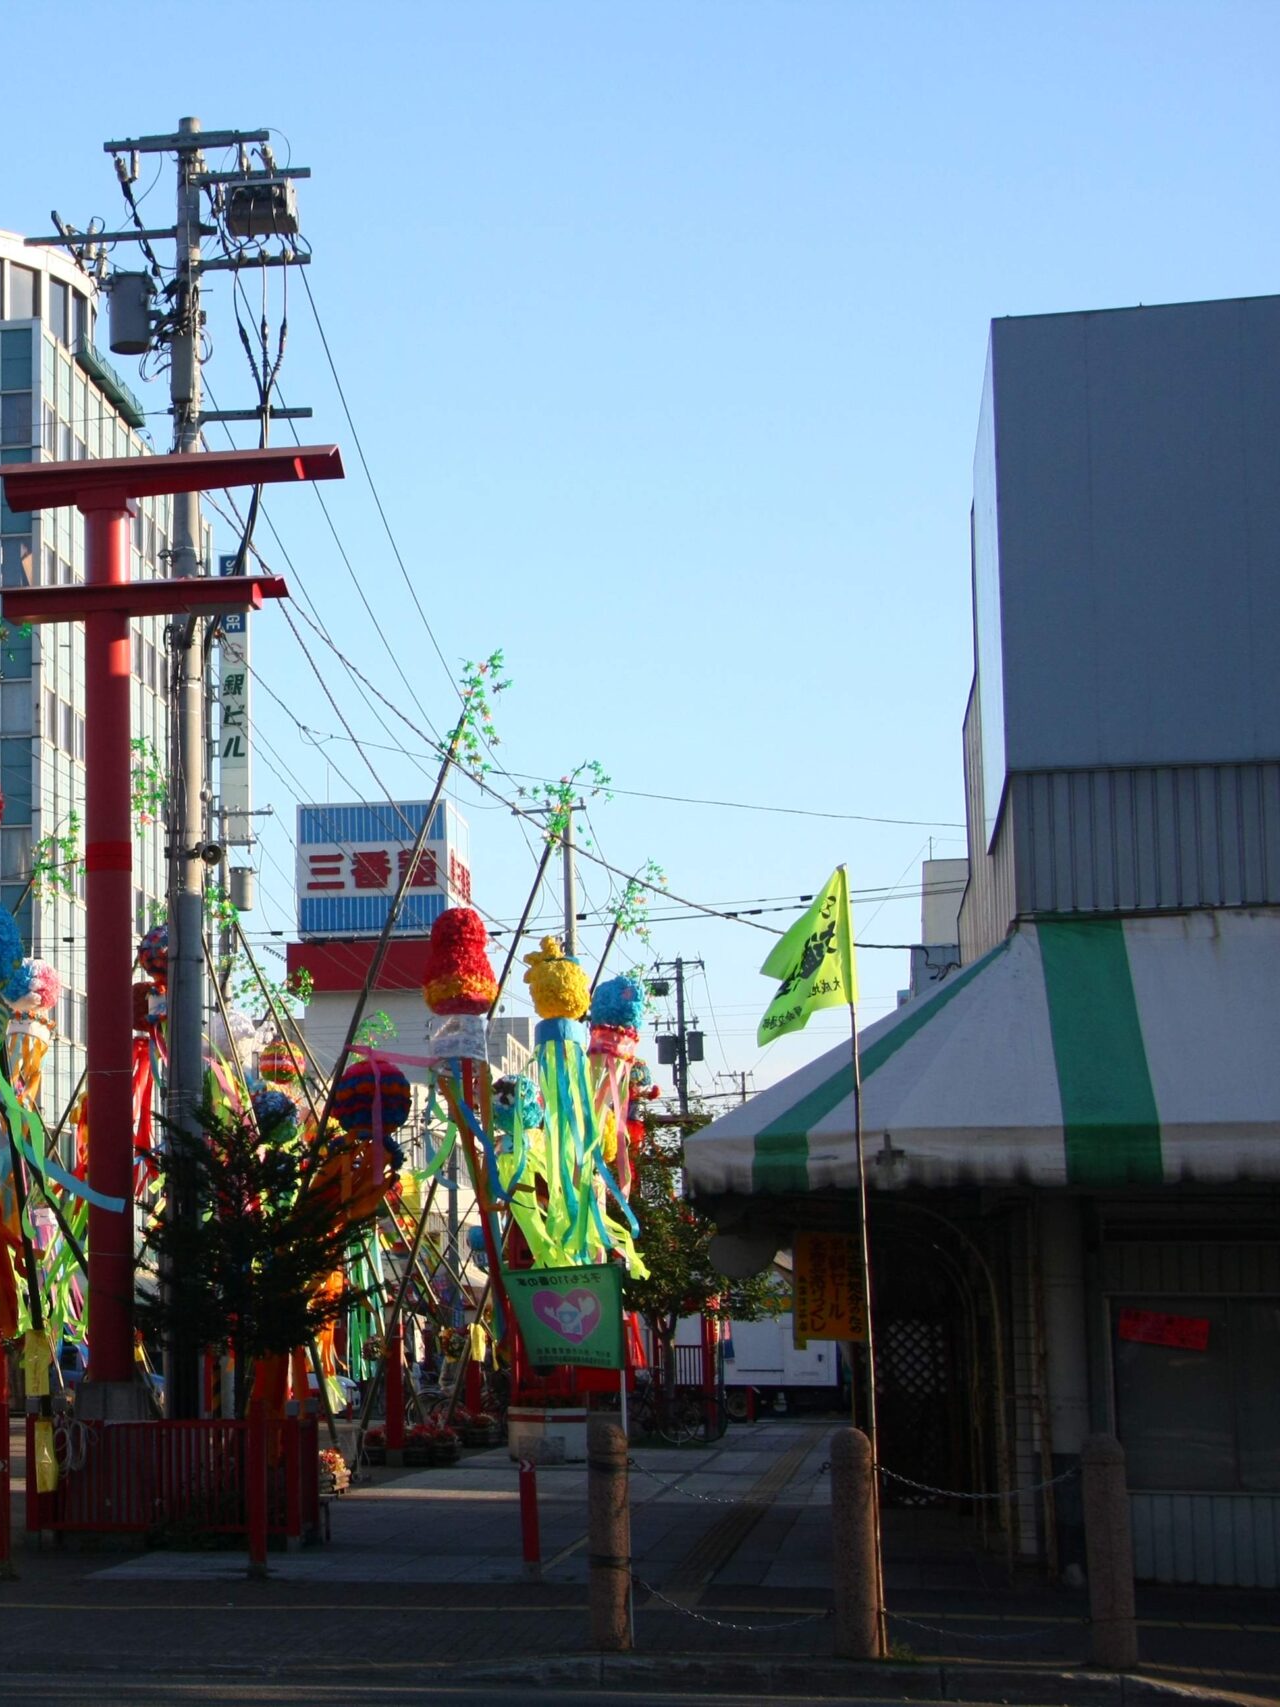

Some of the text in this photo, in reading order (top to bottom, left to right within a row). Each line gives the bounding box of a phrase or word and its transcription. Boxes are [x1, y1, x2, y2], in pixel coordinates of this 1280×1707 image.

[223, 674, 246, 758] 銀ビル
[307, 847, 436, 890] 三番館
